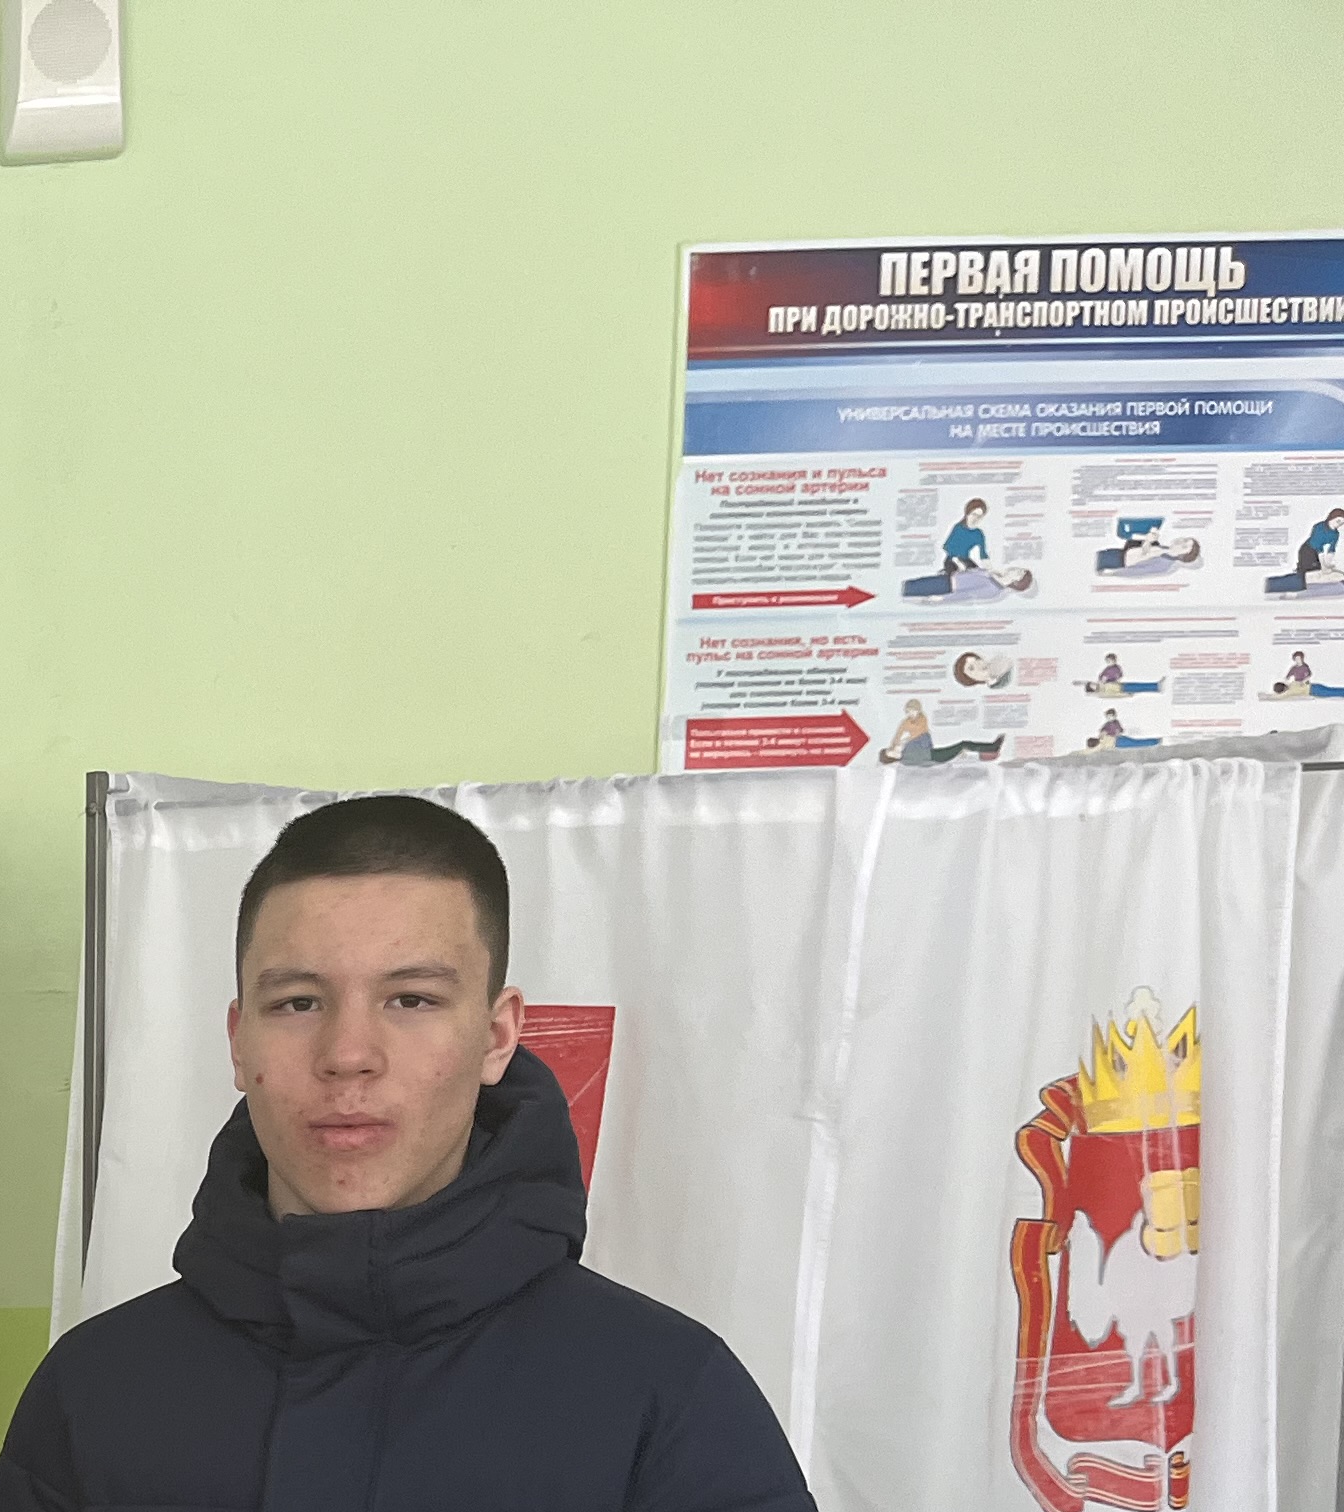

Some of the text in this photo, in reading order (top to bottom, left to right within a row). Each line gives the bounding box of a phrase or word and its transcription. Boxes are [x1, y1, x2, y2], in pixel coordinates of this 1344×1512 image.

[878, 245, 1247, 298] ПЕРВАЯ ПОМОЩЬ
[768, 306, 817, 334] ПРИ
[821, 299, 1148, 336] ДОРОЖНО-ТРАНСПОРТНОМ
[838, 398, 1275, 423] УНИВЕРСАЛЬНАЯ СХЕМА ОКАЗАНИЯ ПЕРВОЙ ПОМОЩИ
[948, 420, 1161, 439] НА МЕСТЕ ПРОИСШЕСТВИЯ
